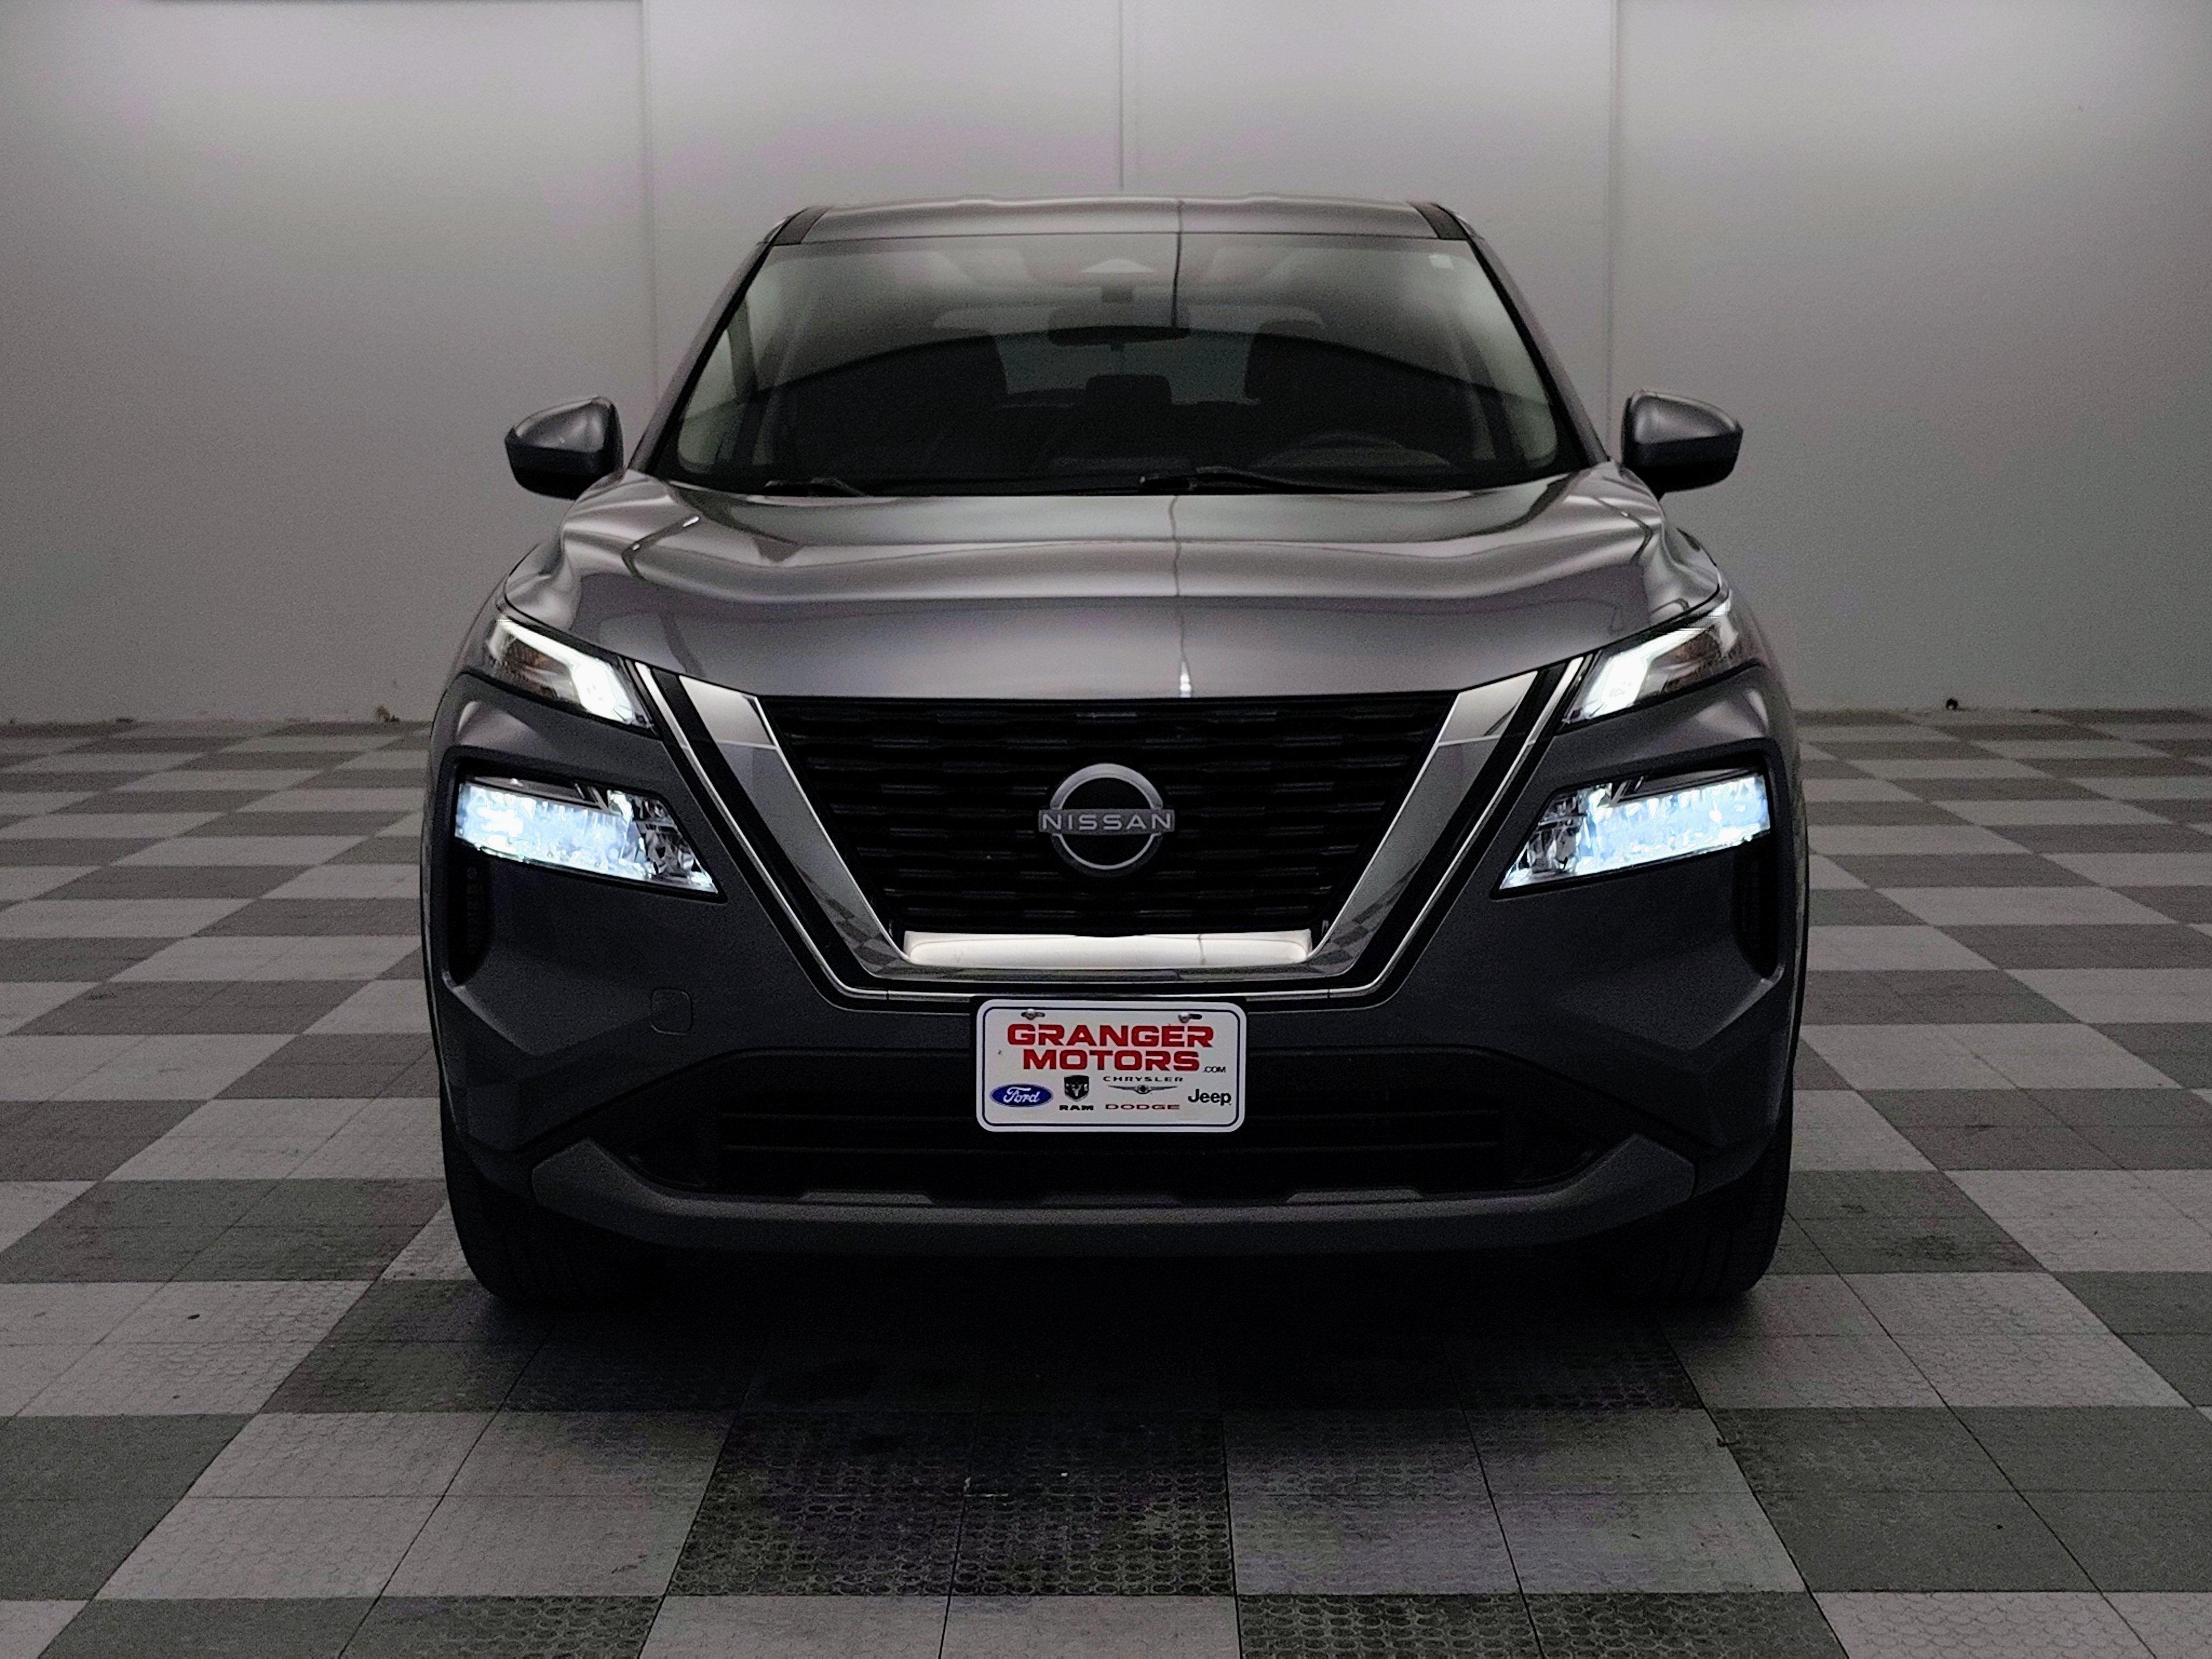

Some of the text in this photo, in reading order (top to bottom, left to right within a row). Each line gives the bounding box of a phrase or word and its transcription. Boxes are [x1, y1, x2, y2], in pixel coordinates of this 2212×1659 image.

[1042, 813, 1171, 830] NISSAN
[1007, 1023, 1214, 1048] GRANGER
[1022, 1049, 1200, 1071] MOTORS
[1002, 1087, 1041, 1104] Ford
[1188, 1088, 1231, 1106] Jeep
